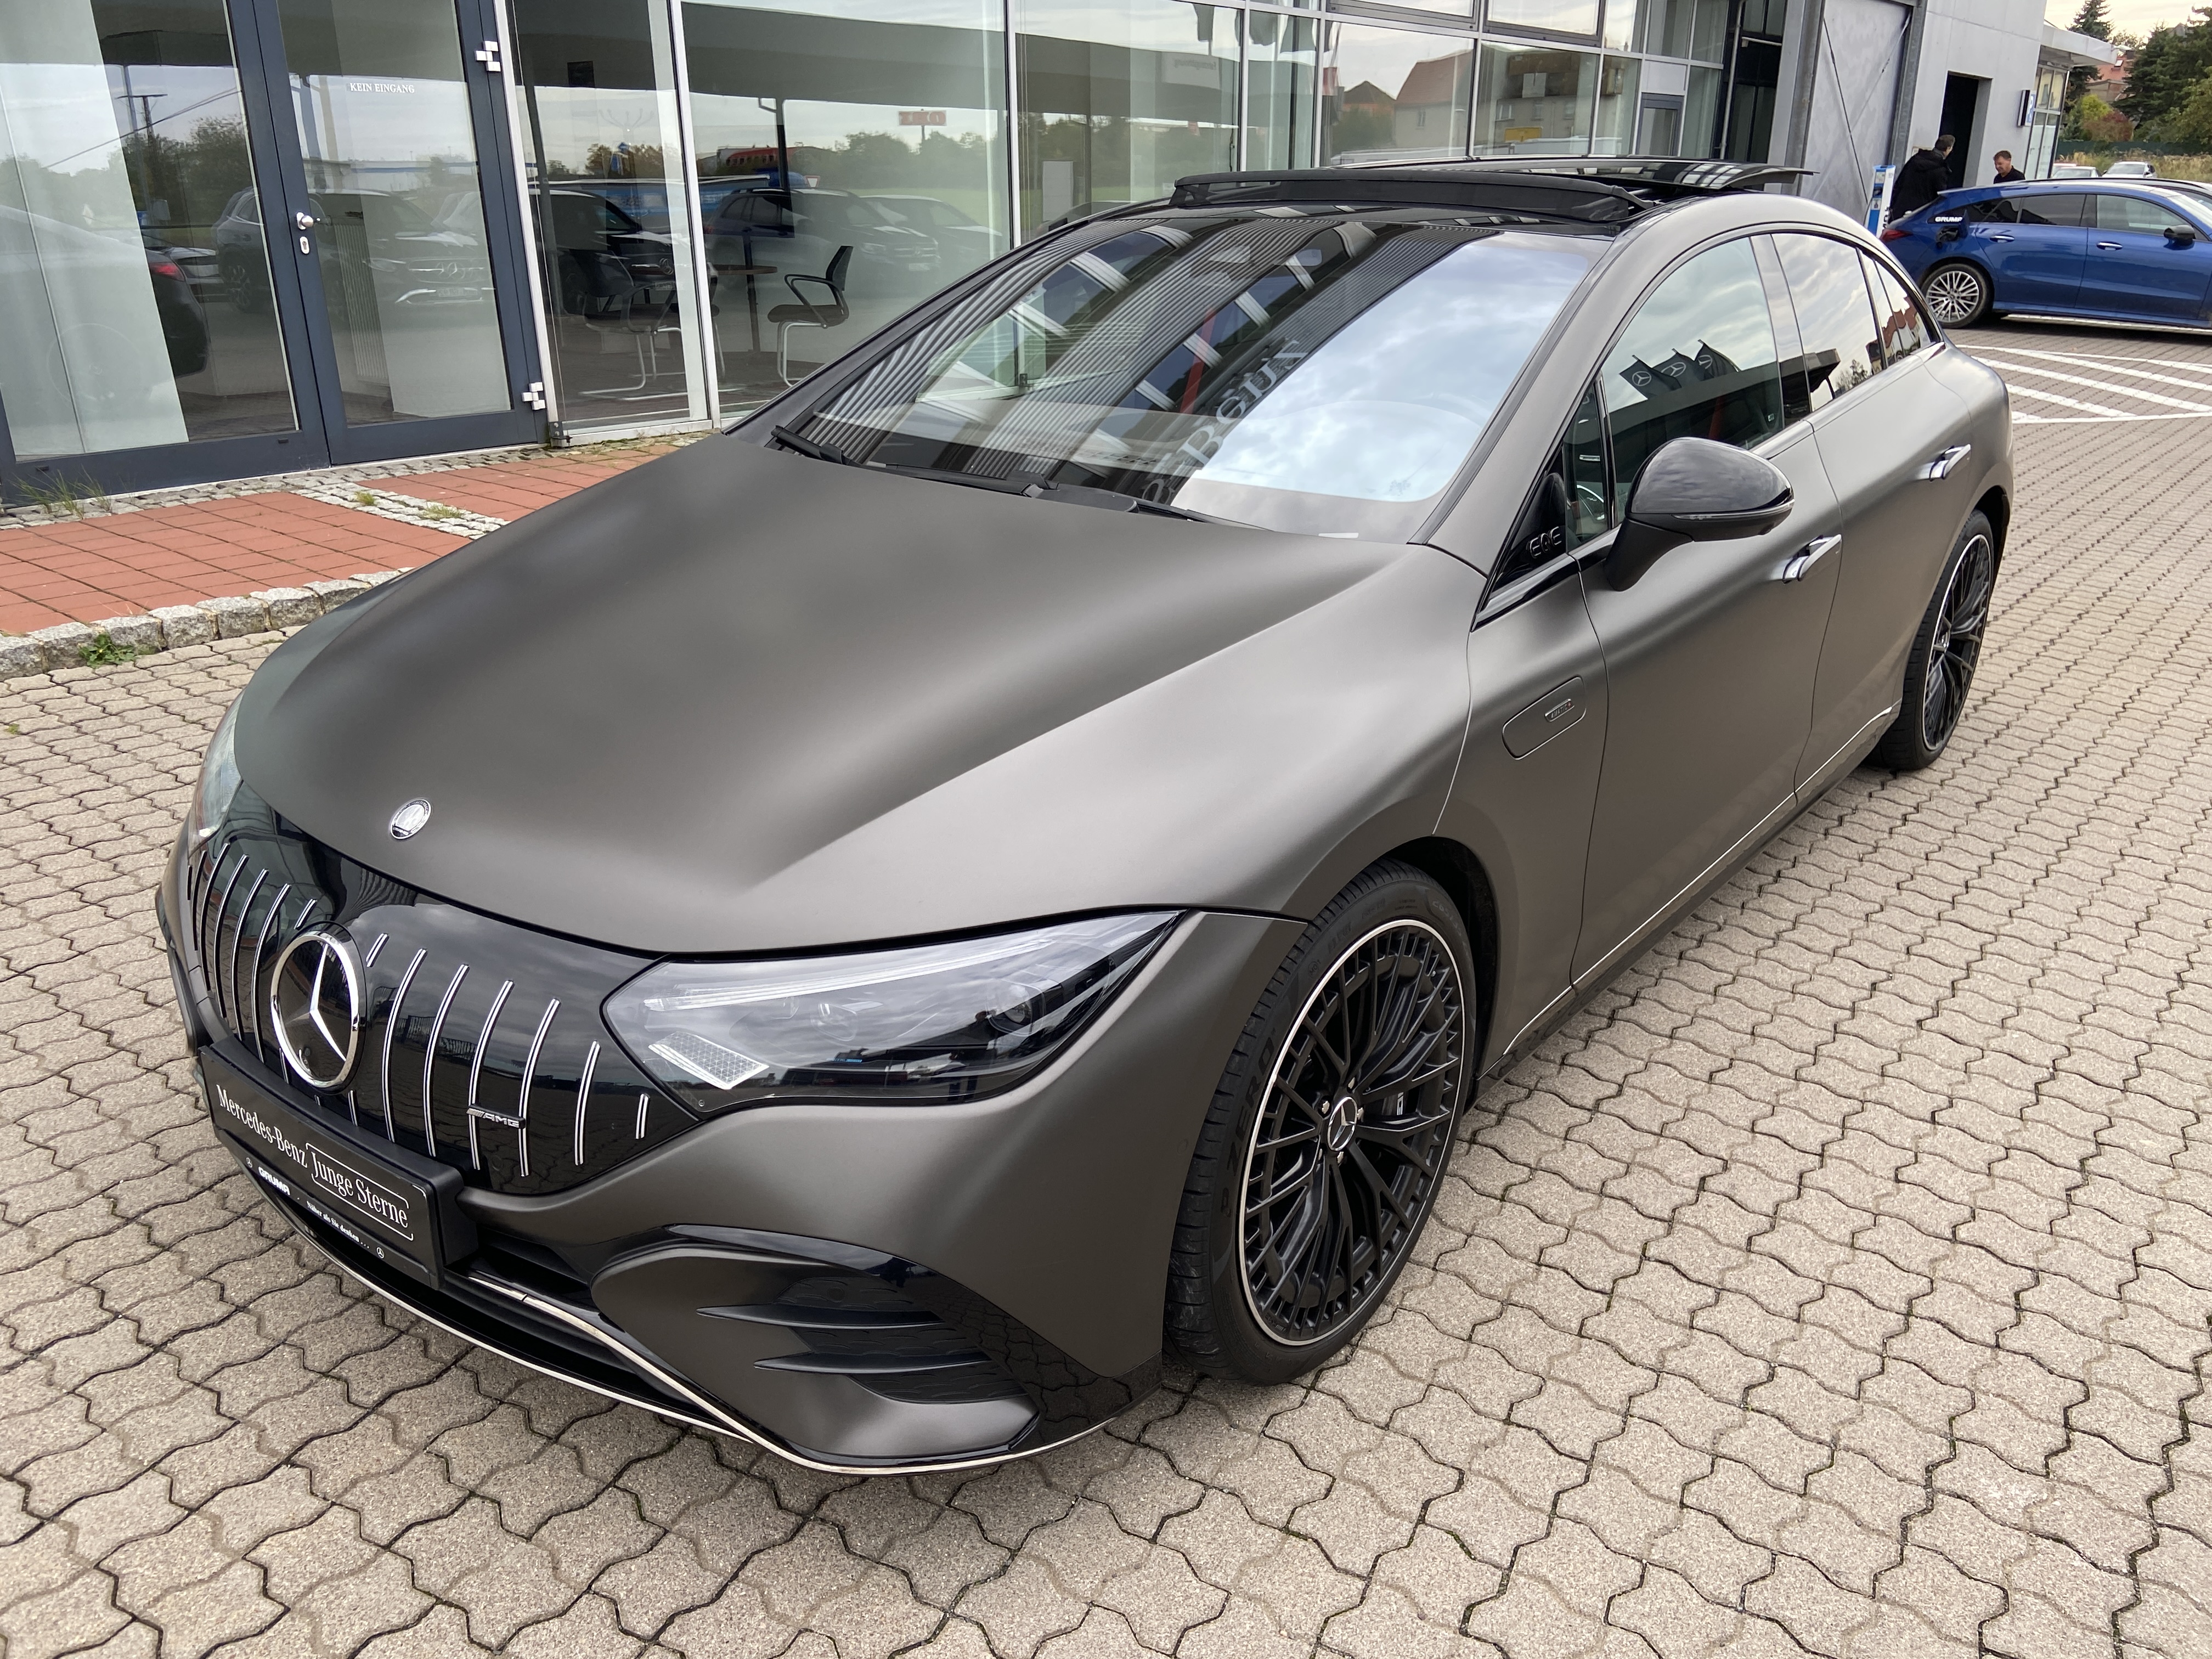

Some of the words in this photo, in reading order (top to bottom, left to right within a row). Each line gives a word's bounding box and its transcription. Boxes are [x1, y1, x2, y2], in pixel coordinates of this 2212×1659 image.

[349, 83, 373, 92] KEIN
[375, 83, 415, 94] EINGANG
[1530, 526, 1562, 558] EQE
[482, 1112, 520, 1128] AMG
[1226, 1036, 1275, 1177] ZERO
[216, 1084, 308, 1168] Mercedes-Benz
[311, 1151, 354, 1197] Junge
[356, 1178, 408, 1228] Sterne
[258, 1166, 291, 1196] GRUMA
[306, 1200, 323, 1217] Näher
[323, 1214, 331, 1223] als
[331, 1217, 340, 1229] Sie
[340, 1223, 359, 1243] denken
